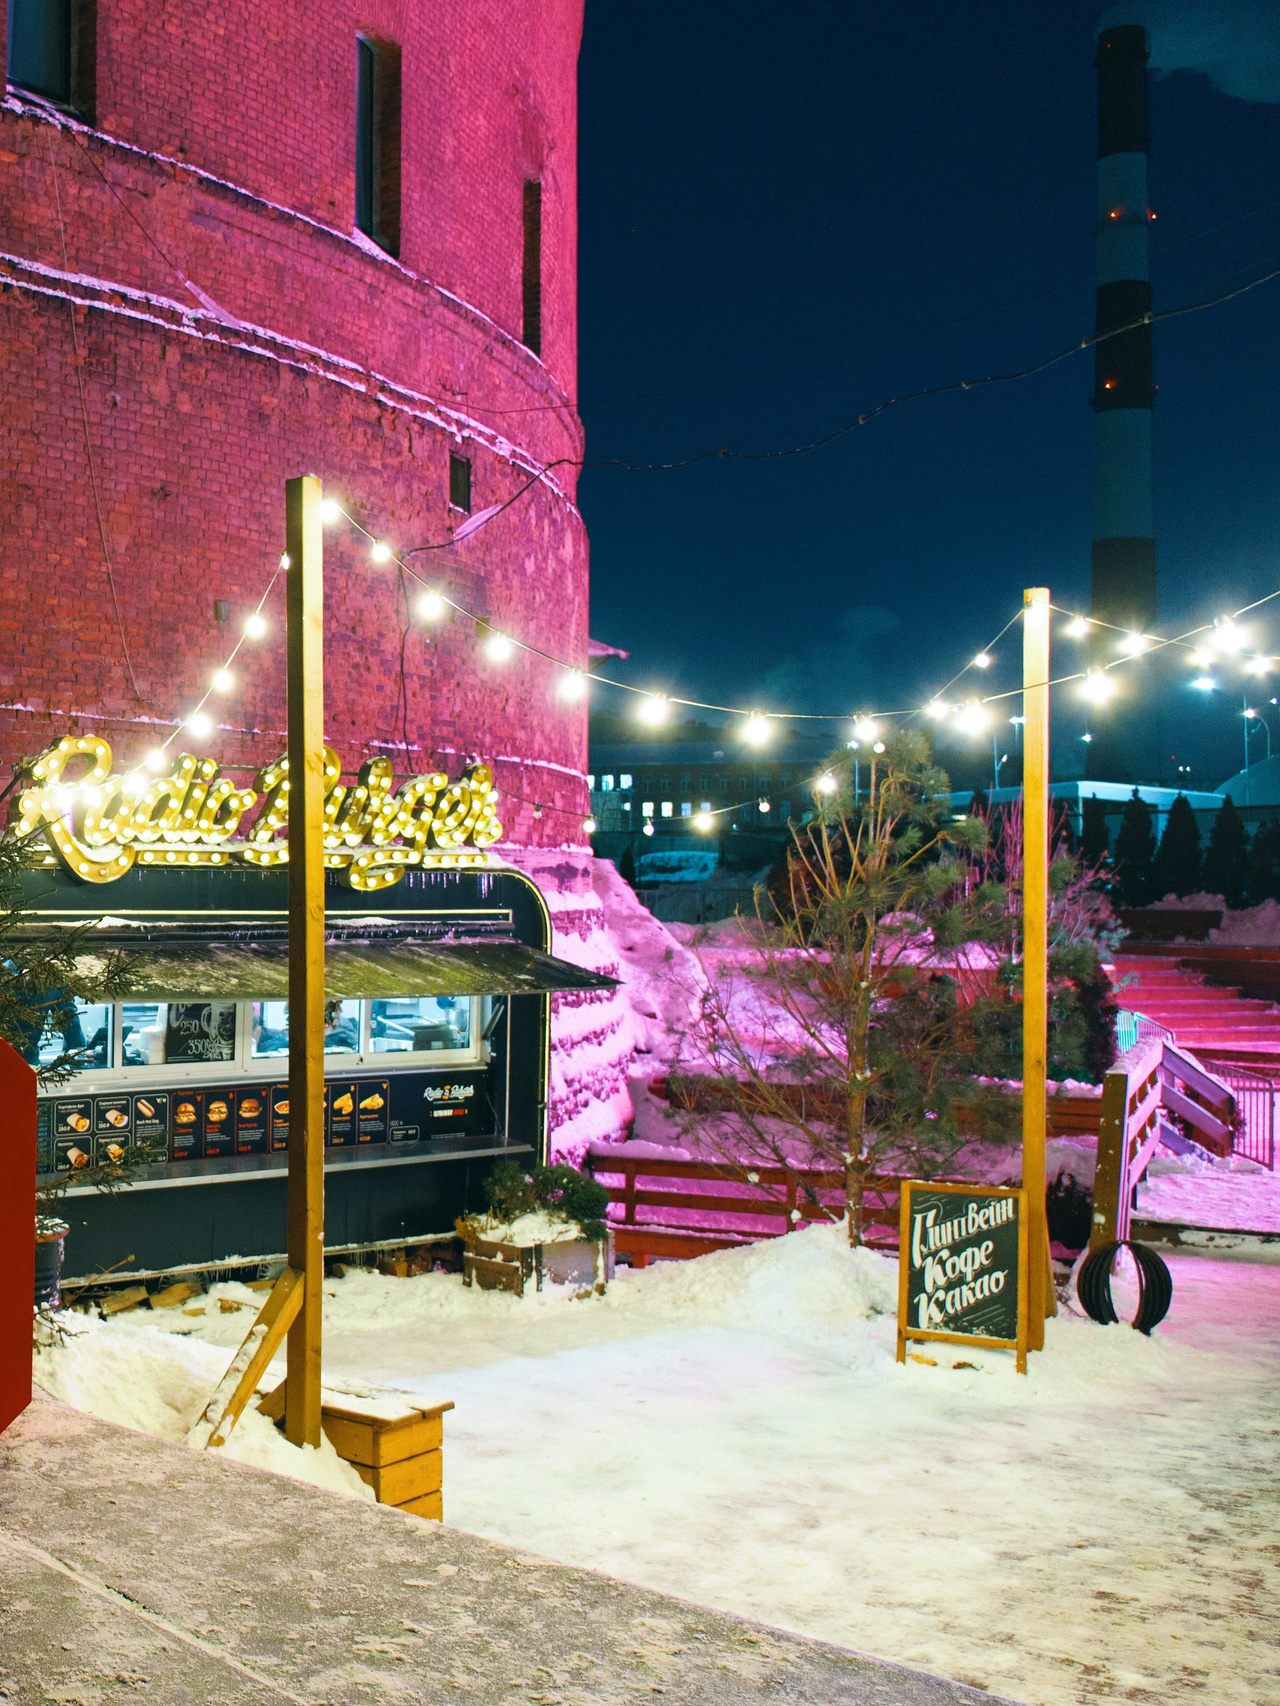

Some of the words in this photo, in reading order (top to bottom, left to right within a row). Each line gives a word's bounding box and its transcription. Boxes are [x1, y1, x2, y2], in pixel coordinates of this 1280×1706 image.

[15, 736, 257, 884] Radio
[180, 1020, 199, 1035] 250
[187, 1038, 207, 1055] 350
[912, 1197, 1014, 1269] Глинтвейн
[922, 1240, 995, 1294] Кофе
[913, 1269, 1009, 1329] Какао
